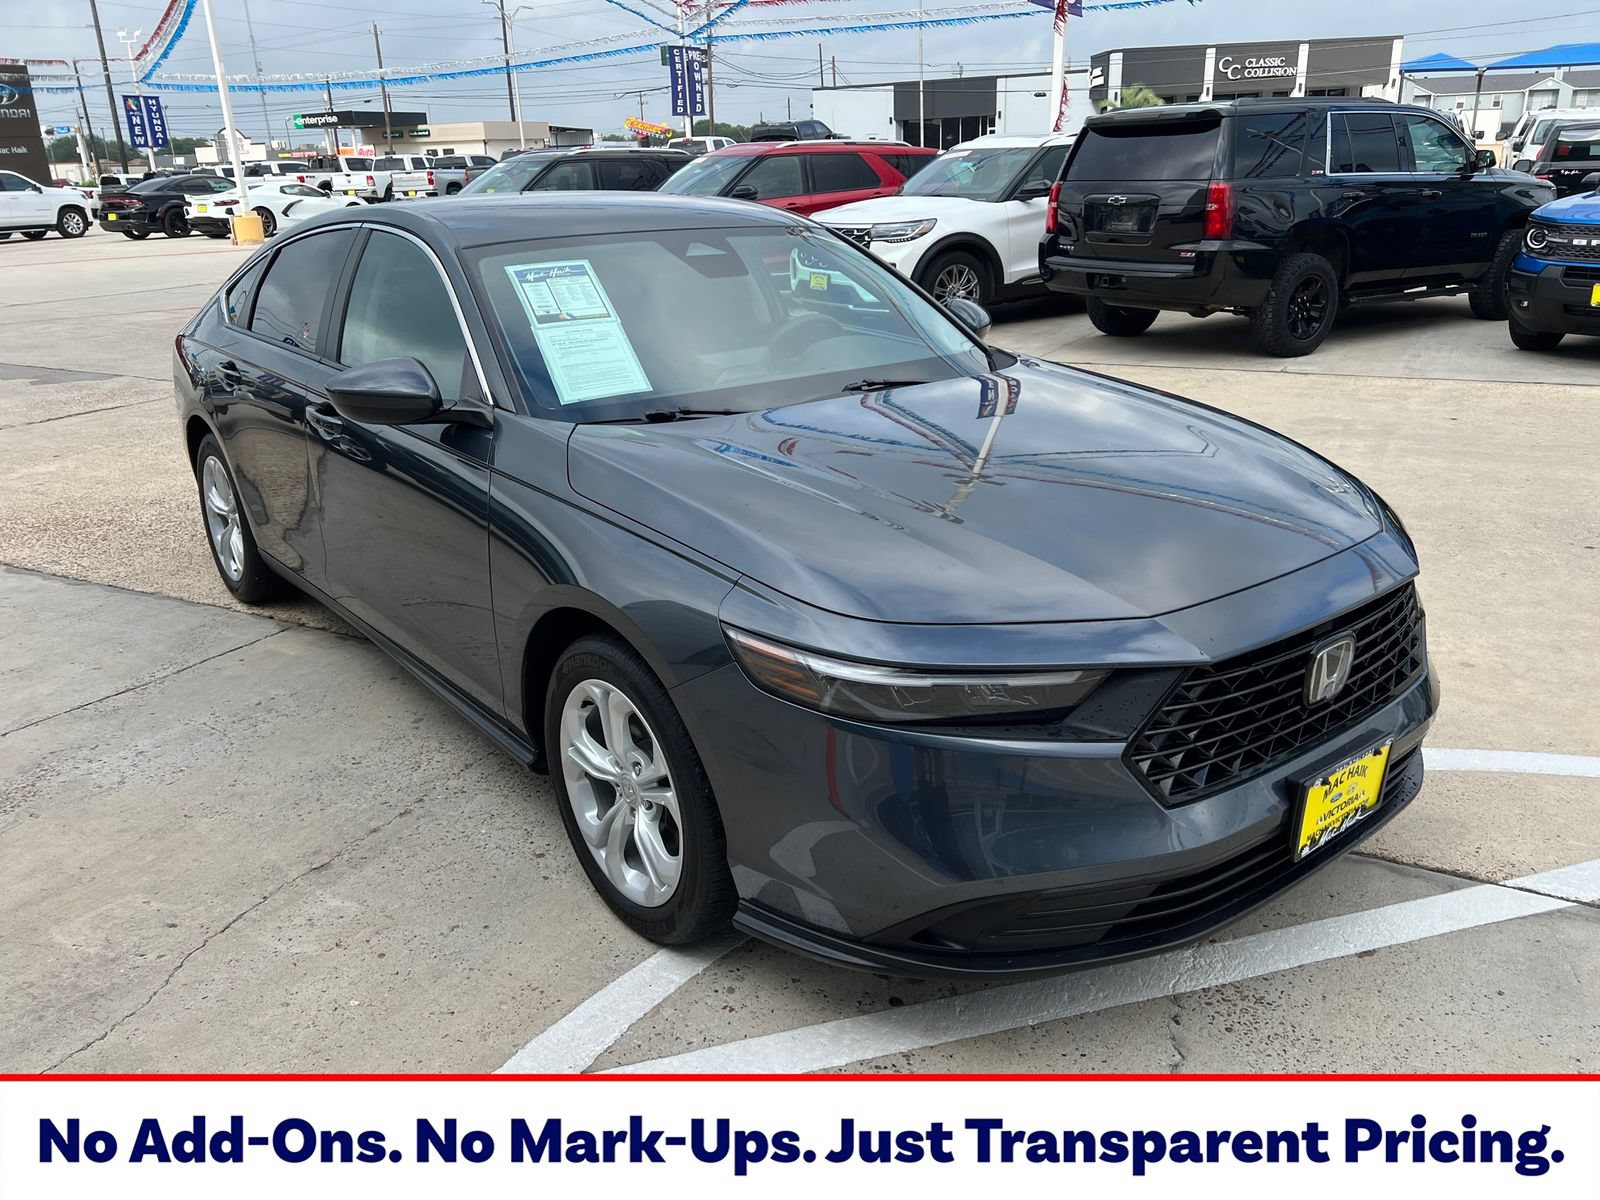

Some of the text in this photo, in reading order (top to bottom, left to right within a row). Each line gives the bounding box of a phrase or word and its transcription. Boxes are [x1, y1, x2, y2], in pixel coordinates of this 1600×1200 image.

[1243, 66, 1298, 78] COLLISION
[1244, 57, 1286, 68] CLASSIC
[673, 48, 684, 113] CERTIFIED
[693, 62, 702, 112] OWNED
[131, 115, 145, 145] NEW
[148, 98, 164, 145] HYUNDAI
[294, 114, 338, 126] enterprise
[11, 146, 28, 154] Haik
[525, 266, 579, 282] Mac Haik
[1322, 772, 1346, 803] MAC
[1346, 764, 1369, 780] HAIK
